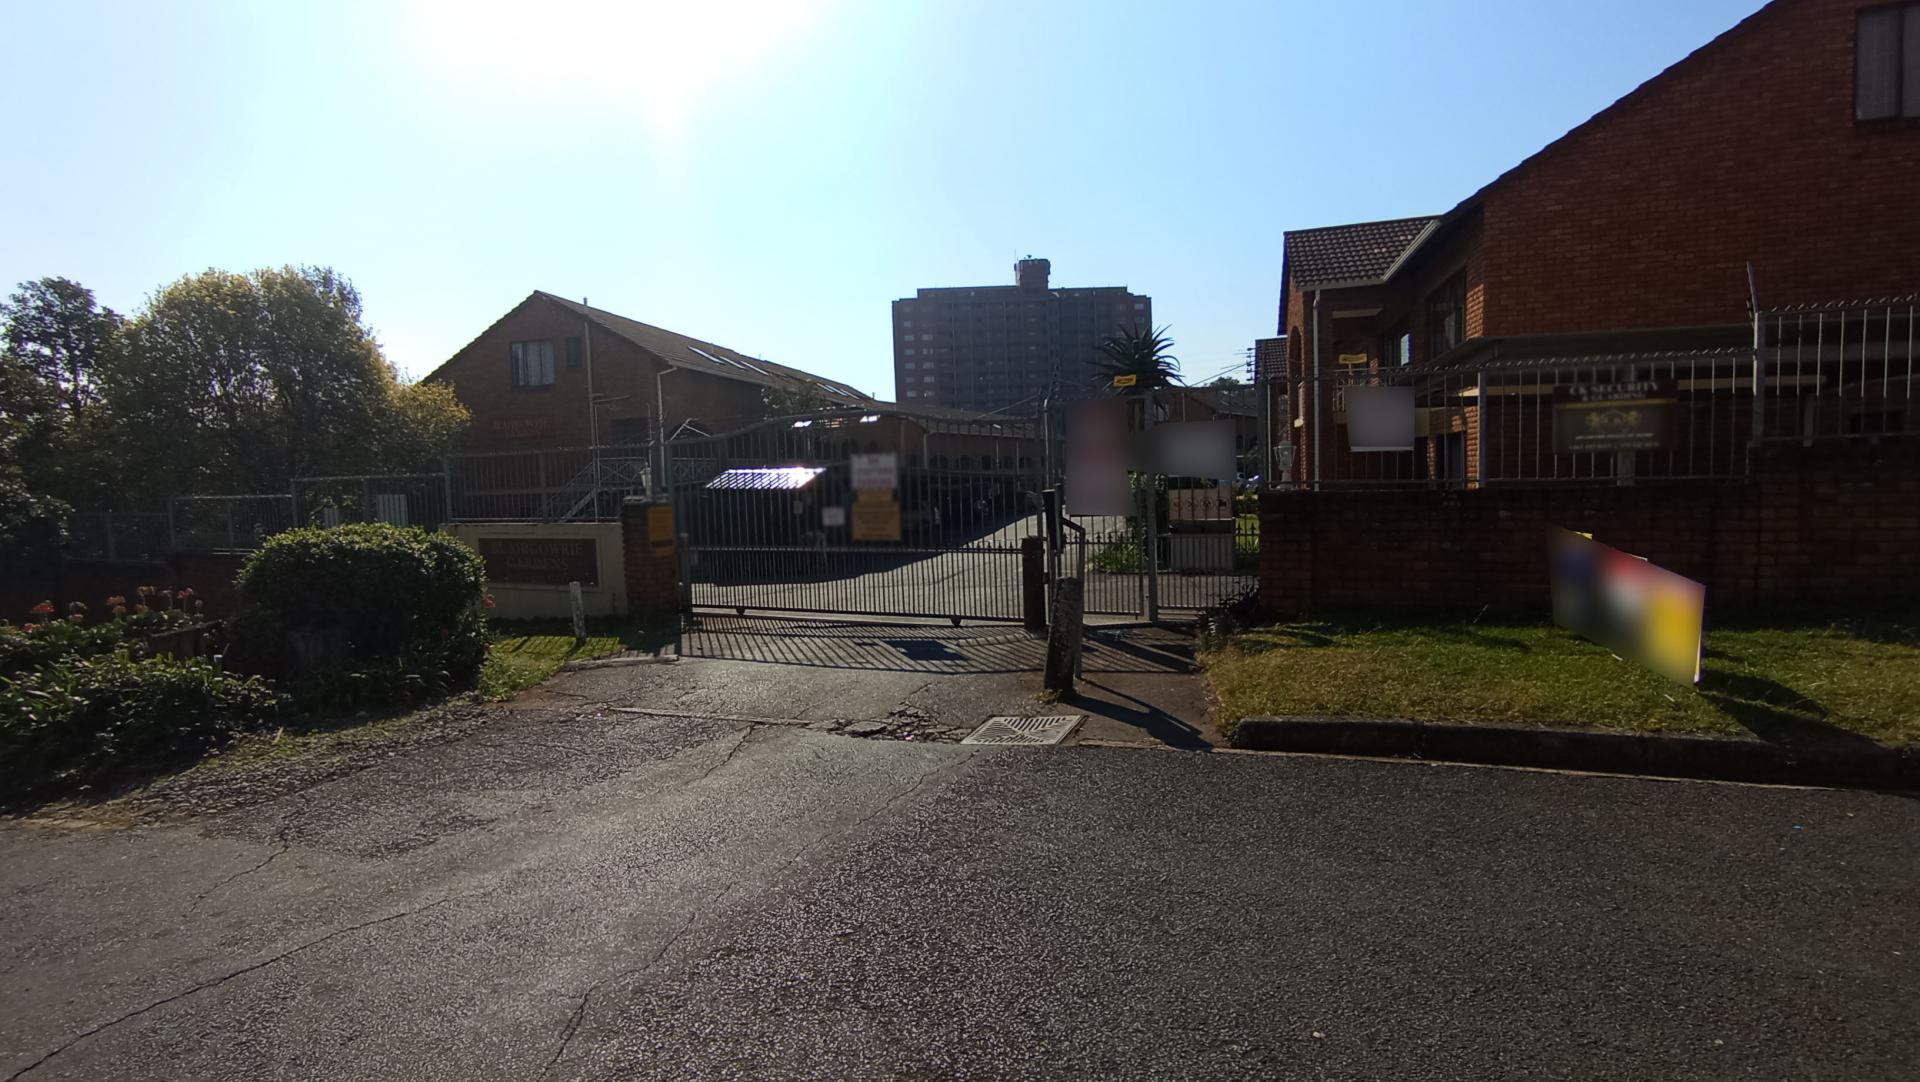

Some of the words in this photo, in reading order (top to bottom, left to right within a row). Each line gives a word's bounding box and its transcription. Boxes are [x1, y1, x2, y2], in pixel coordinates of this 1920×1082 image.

[1591, 381, 1658, 393] SECURITY
[491, 543, 584, 556] BLAIRGOWRIE
[506, 558, 569, 570] GARDENS
